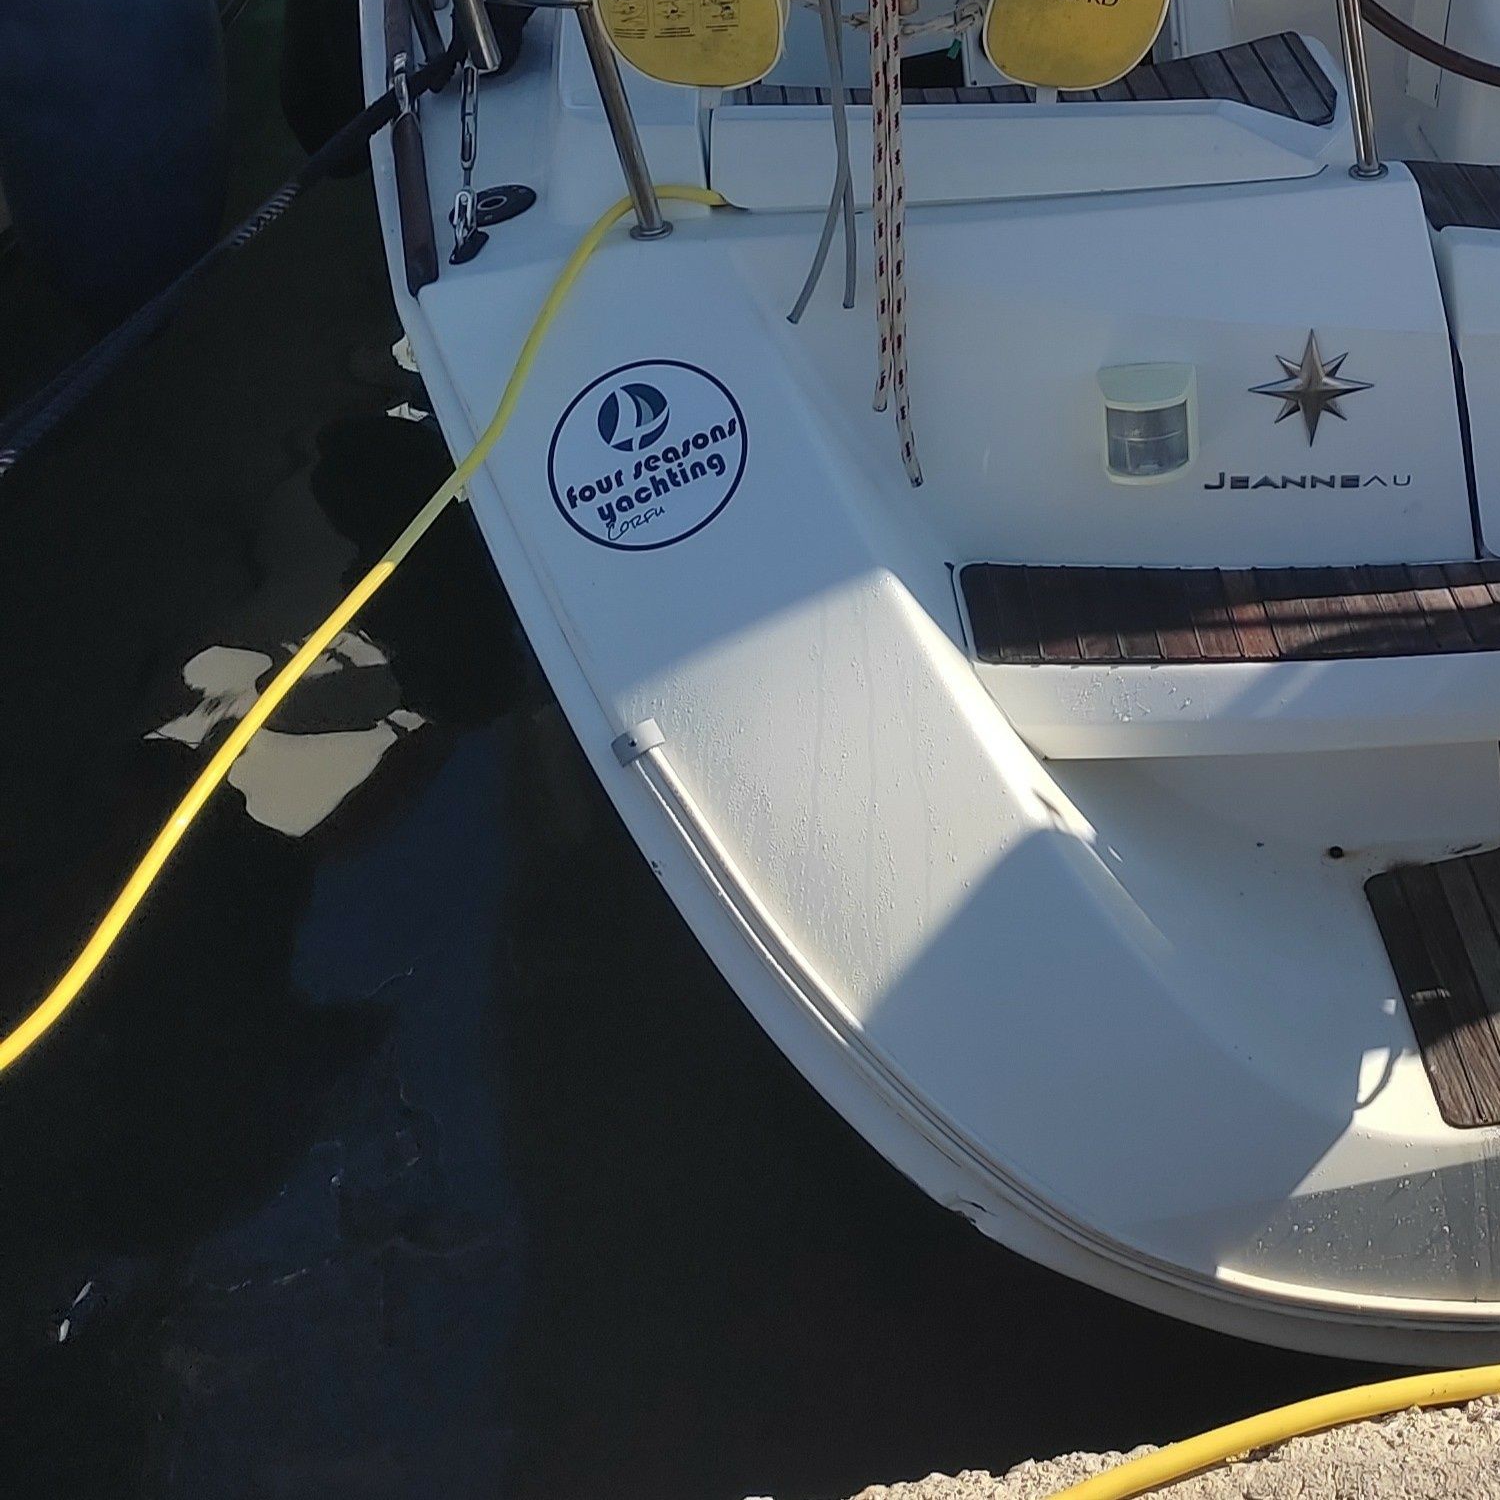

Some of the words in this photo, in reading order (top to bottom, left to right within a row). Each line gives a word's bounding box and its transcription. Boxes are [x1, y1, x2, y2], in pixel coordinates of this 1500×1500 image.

[566, 468, 624, 509] four
[633, 417, 737, 481] seasons
[597, 453, 727, 527] yachting
